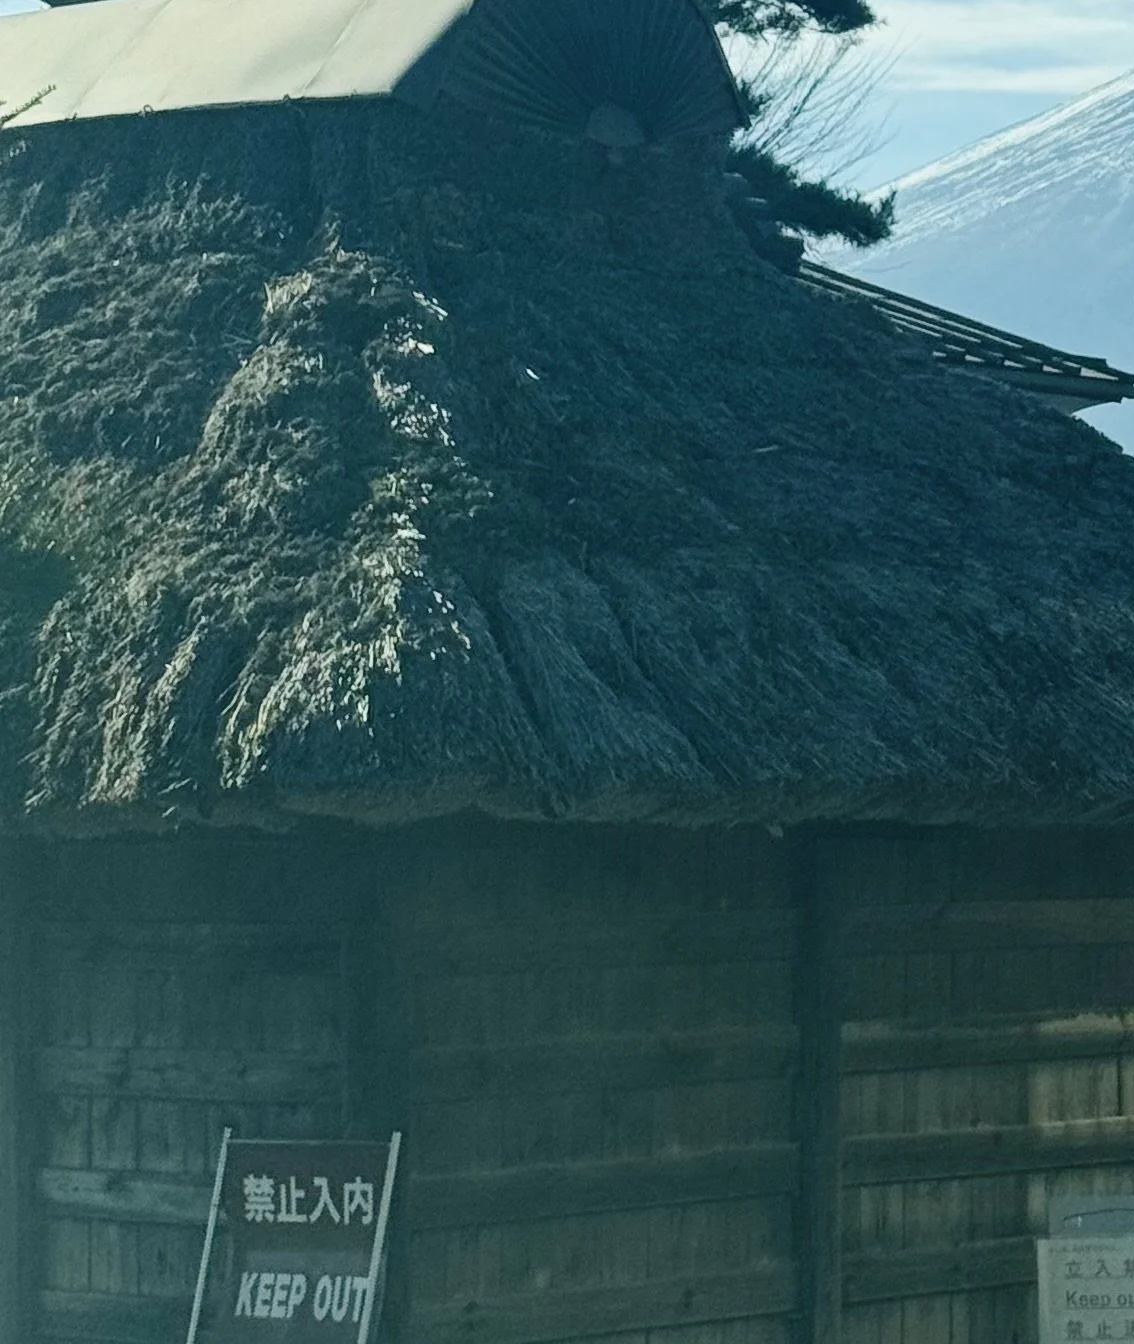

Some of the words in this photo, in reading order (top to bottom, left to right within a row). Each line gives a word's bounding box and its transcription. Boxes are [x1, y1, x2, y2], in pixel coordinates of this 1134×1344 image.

[243, 1174, 373, 1225] 禁止入内
[235, 1272, 308, 1319] KEEP
[313, 1274, 371, 1323] OUT
[1065, 1289, 1111, 1308] Keep
